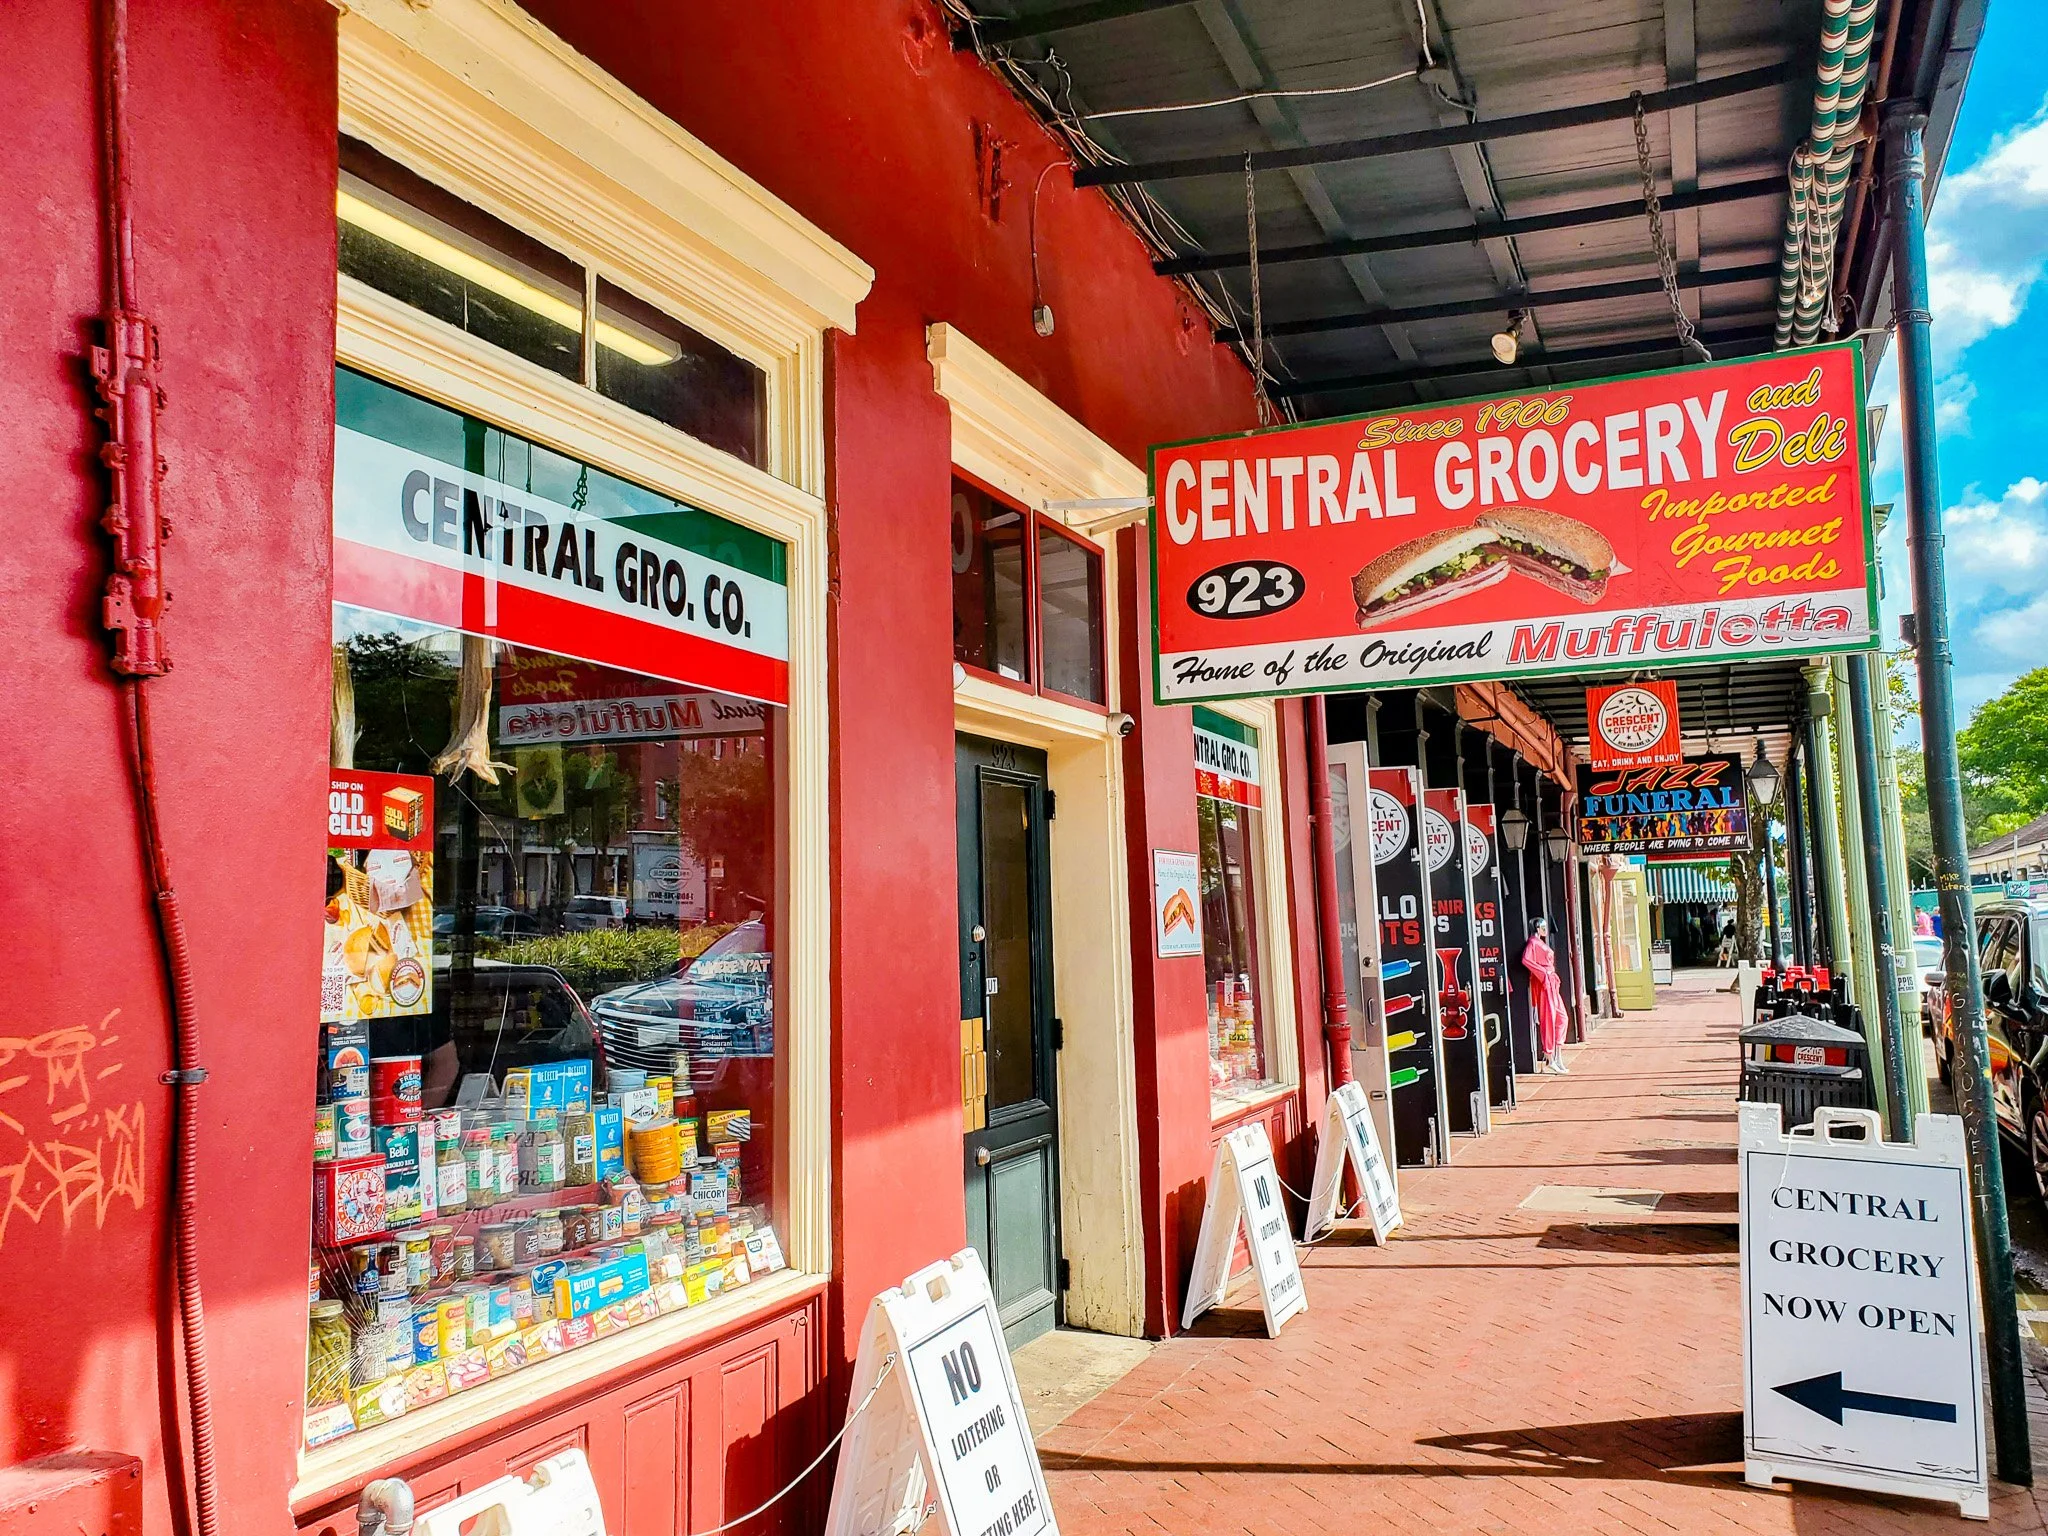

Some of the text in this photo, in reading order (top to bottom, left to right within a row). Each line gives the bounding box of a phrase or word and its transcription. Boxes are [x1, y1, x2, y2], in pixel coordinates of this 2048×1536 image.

[1747, 367, 1822, 412] and
[1358, 395, 1571, 451] Since 1906
[1728, 412, 1847, 475] Deli
[1164, 389, 1729, 545] CENTRAL GROCERY
[1640, 474, 1837, 523] Imported
[401, 468, 752, 639] CENTRAL GRO. CO.
[1671, 518, 1841, 568] Gourmet
[1196, 566, 1297, 615] 923
[1711, 556, 1842, 595] Foods
[1172, 655, 1254, 686] Home
[1262, 651, 1293, 690] of
[1303, 647, 1348, 674] the
[1360, 631, 1494, 674] Original
[1605, 713, 1661, 727] CRESCENT
[1632, 724, 1652, 732] CAFE
[991, 744, 1015, 770] 923
[1222, 743, 1239, 774] GRO.
[1240, 750, 1252, 778] CO.
[1592, 753, 1679, 768] EAT, DRINK AND ENJOY
[331, 781, 363, 791] SHIP ON
[1590, 761, 1731, 795] JAZZ
[1583, 786, 1740, 817] FUNERAL
[1583, 835, 1747, 853] WHERE PEOPLE ARE DYING TO COME IN!
[1480, 947, 1500, 957] TAP
[1797, 1053, 1823, 1062] CRESCENT
[1356, 1121, 1369, 1149] NO
[390, 1147, 408, 1159] Bello
[693, 1189, 726, 1200] CHICORY
[1254, 1175, 1270, 1210] NO
[1772, 1186, 1939, 1223] CENTRAL
[1260, 1217, 1281, 1241] LOITERING
[1275, 1250, 1281, 1265] OR
[1769, 1239, 1945, 1279] GROCERY
[1271, 1272, 1296, 1302] SITTING HERE
[1762, 1292, 1957, 1337] NOW OPEN
[941, 1341, 982, 1406] NO
[951, 1404, 1005, 1461] LOITERING
[984, 1464, 1001, 1493] OR
[1011, 1489, 1037, 1528] HERE
